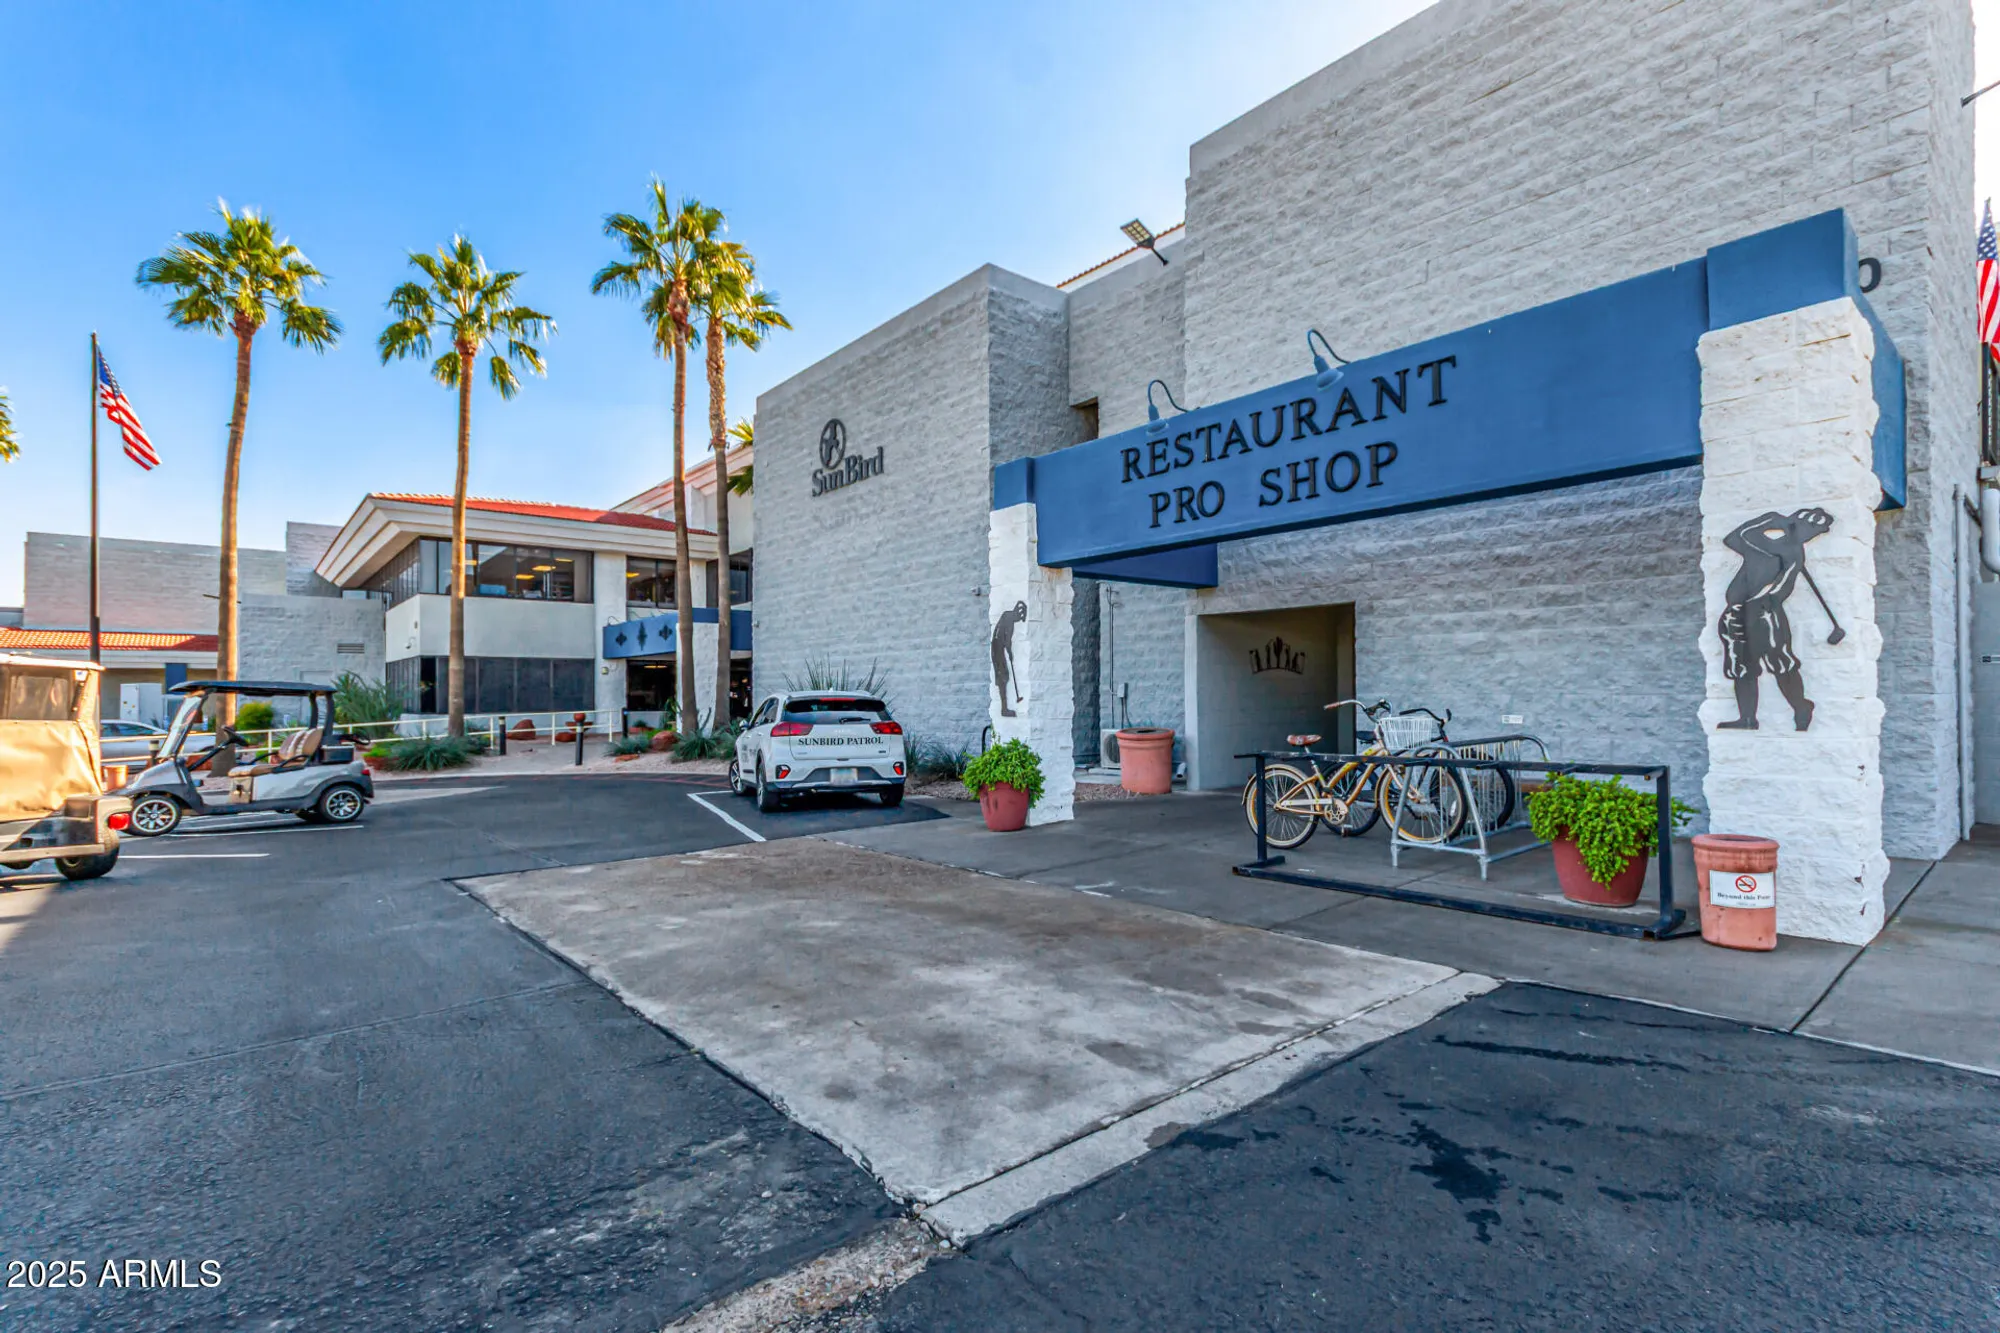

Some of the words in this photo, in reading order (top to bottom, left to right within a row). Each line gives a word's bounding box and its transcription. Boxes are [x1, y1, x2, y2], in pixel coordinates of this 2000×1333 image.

[1120, 354, 1456, 483] RESTAURANT
[1148, 480, 1225, 529] PRO
[1259, 440, 1398, 507] SHOP
[798, 737, 844, 746] SUNBIRD
[846, 736, 884, 745] PATROL
